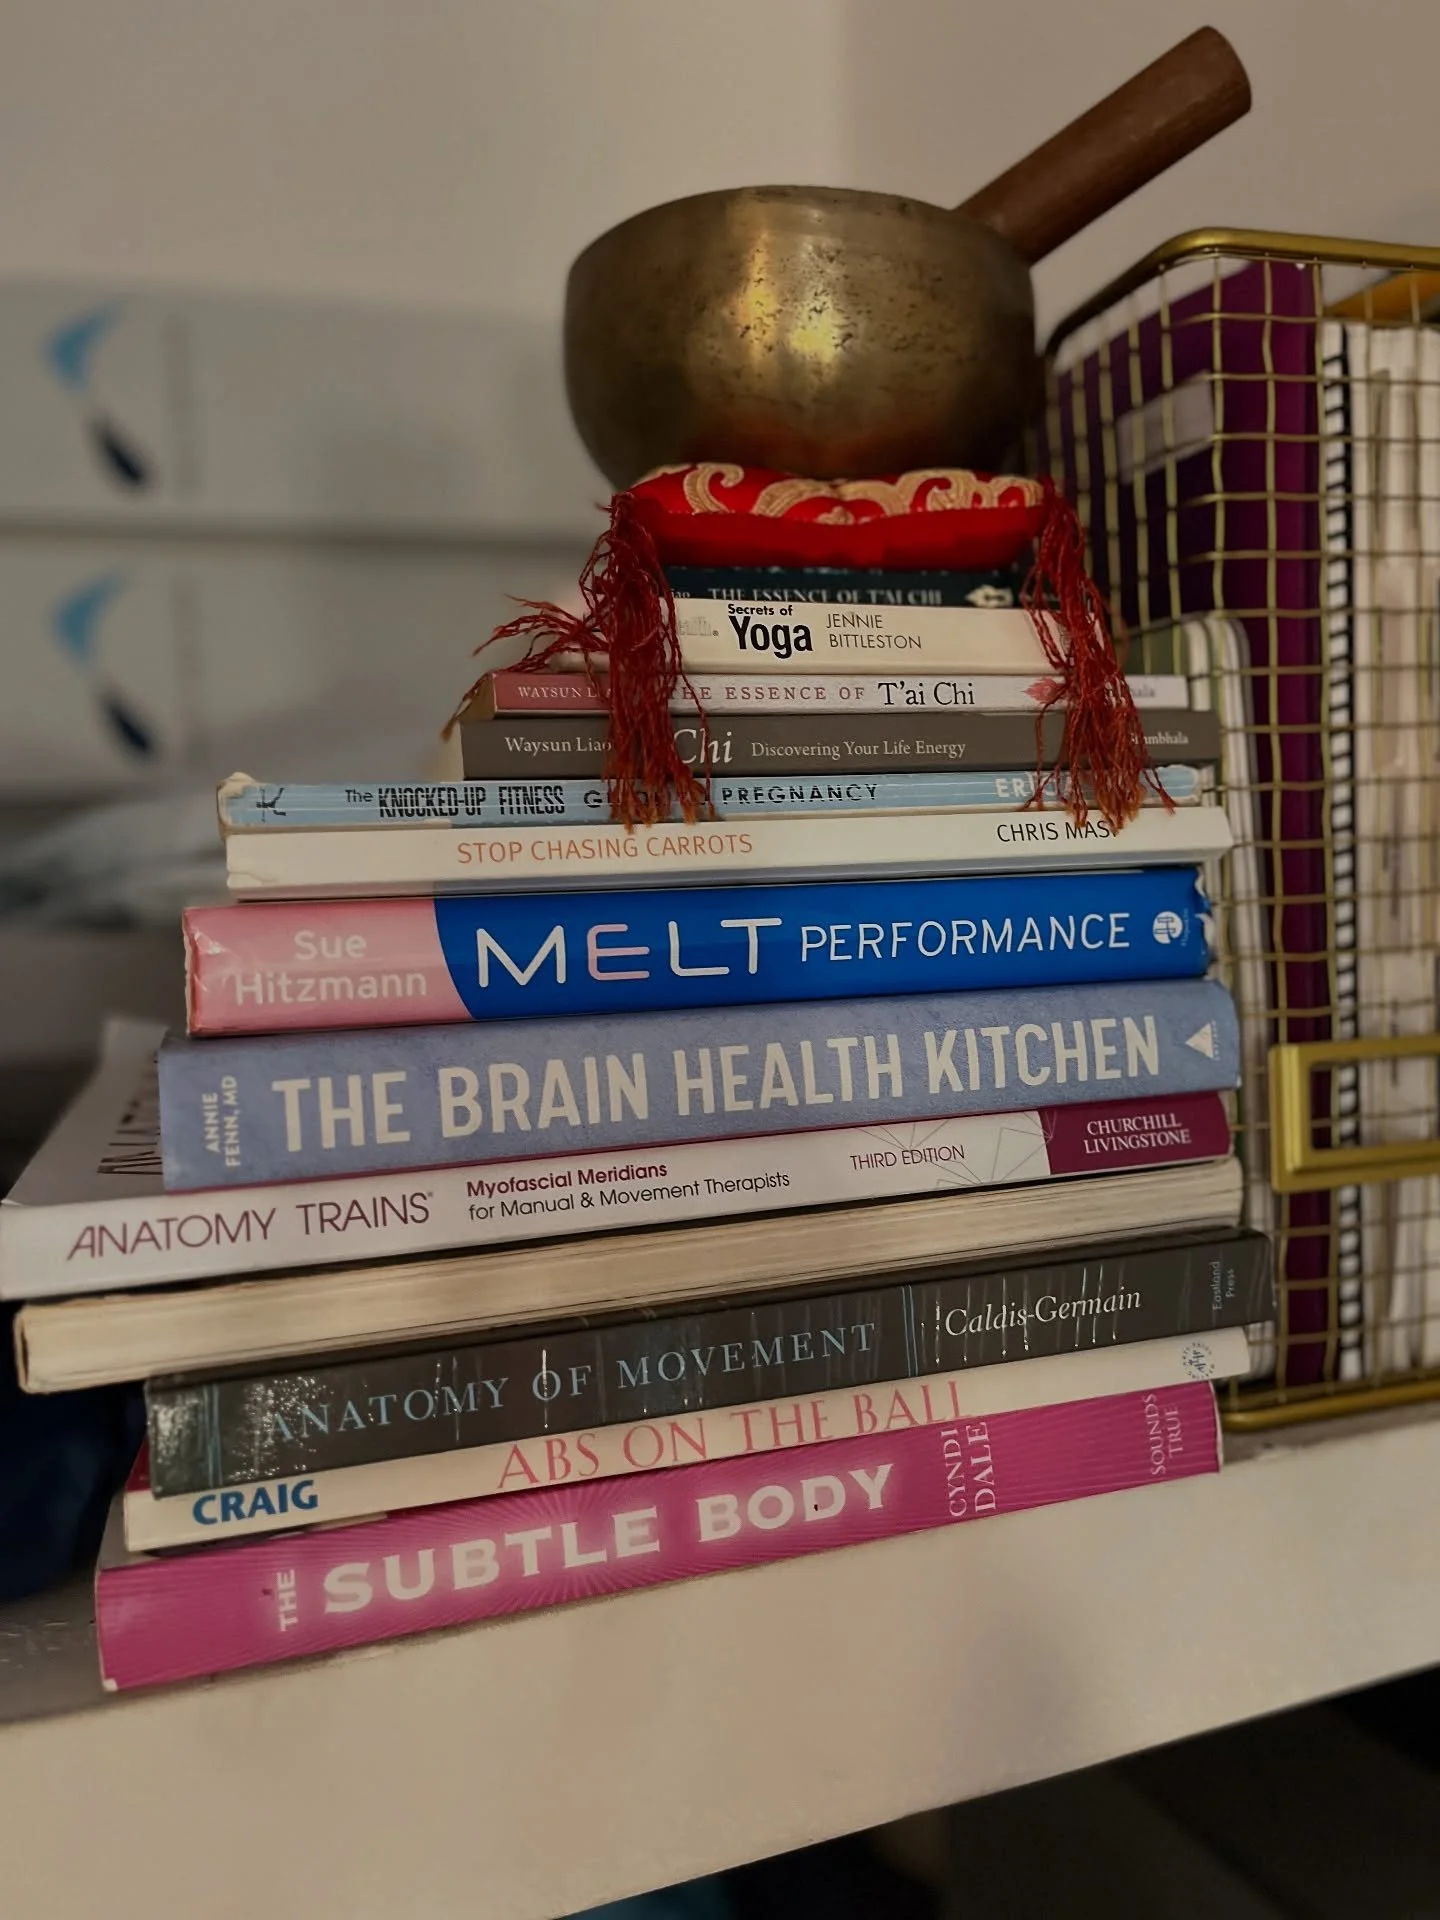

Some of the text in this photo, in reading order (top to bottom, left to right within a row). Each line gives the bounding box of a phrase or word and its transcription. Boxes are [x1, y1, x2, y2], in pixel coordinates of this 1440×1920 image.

[727, 603, 794, 616] Secrets of
[826, 613, 884, 629] JENNIE
[728, 615, 814, 660] Yoga
[828, 633, 923, 650] BITTLESTON
[517, 686, 582, 699] WAYSUN
[672, 685, 713, 701] HE
[725, 686, 827, 701] ESSENCE
[838, 686, 865, 701] OF
[933, 681, 976, 706] Chi
[504, 736, 612, 757] Waysun Liao
[673, 728, 734, 766] Chi
[750, 739, 967, 761] Discovering Your Life Energy
[344, 789, 373, 803] The
[377, 786, 487, 818] KNOCKED-UP
[497, 785, 566, 816] FITNESS
[721, 782, 878, 806] PREGNANCY
[457, 833, 753, 865] STOP CHASING CARROTS
[996, 819, 1119, 844] CHRIS MAS
[293, 930, 368, 961] Sue
[475, 917, 783, 988] MELT
[800, 911, 1131, 963] PERFORMANCE
[235, 970, 428, 1007] Hitzmann
[272, 1071, 411, 1152] THE
[438, 1051, 647, 1138] BRAIN
[673, 1032, 903, 1117] HEALTH
[925, 1014, 1159, 1095] KITCHEN
[202, 1091, 221, 1154] ANNIE
[221, 1075, 242, 1168] FENN, MD
[1083, 1128, 1192, 1155] LIVINGSTONE
[1086, 1112, 1183, 1136] CHURCHILL
[849, 1144, 966, 1171] THIRD EDITION
[466, 1162, 668, 1199] Myofascial Meridians
[468, 1170, 791, 1221] for Manual & Movement Therapists
[67, 1207, 277, 1261] ANATOMY
[1209, 1260, 1223, 1312] Eastland
[944, 1286, 1142, 1338] Caldis-Germain
[266, 1322, 876, 1443] ANATOMY OF MOVEMENT
[496, 1380, 974, 1489] ABS ON THE BALL
[1141, 1393, 1167, 1476] SOUNDS
[1164, 1405, 1184, 1459] TRUE
[940, 1428, 968, 1518] CYNDI
[965, 1420, 997, 1514] DALE
[192, 1479, 319, 1527] CRAIG
[323, 1462, 894, 1616] SUBTLE BODY
[277, 1567, 300, 1632] THE
